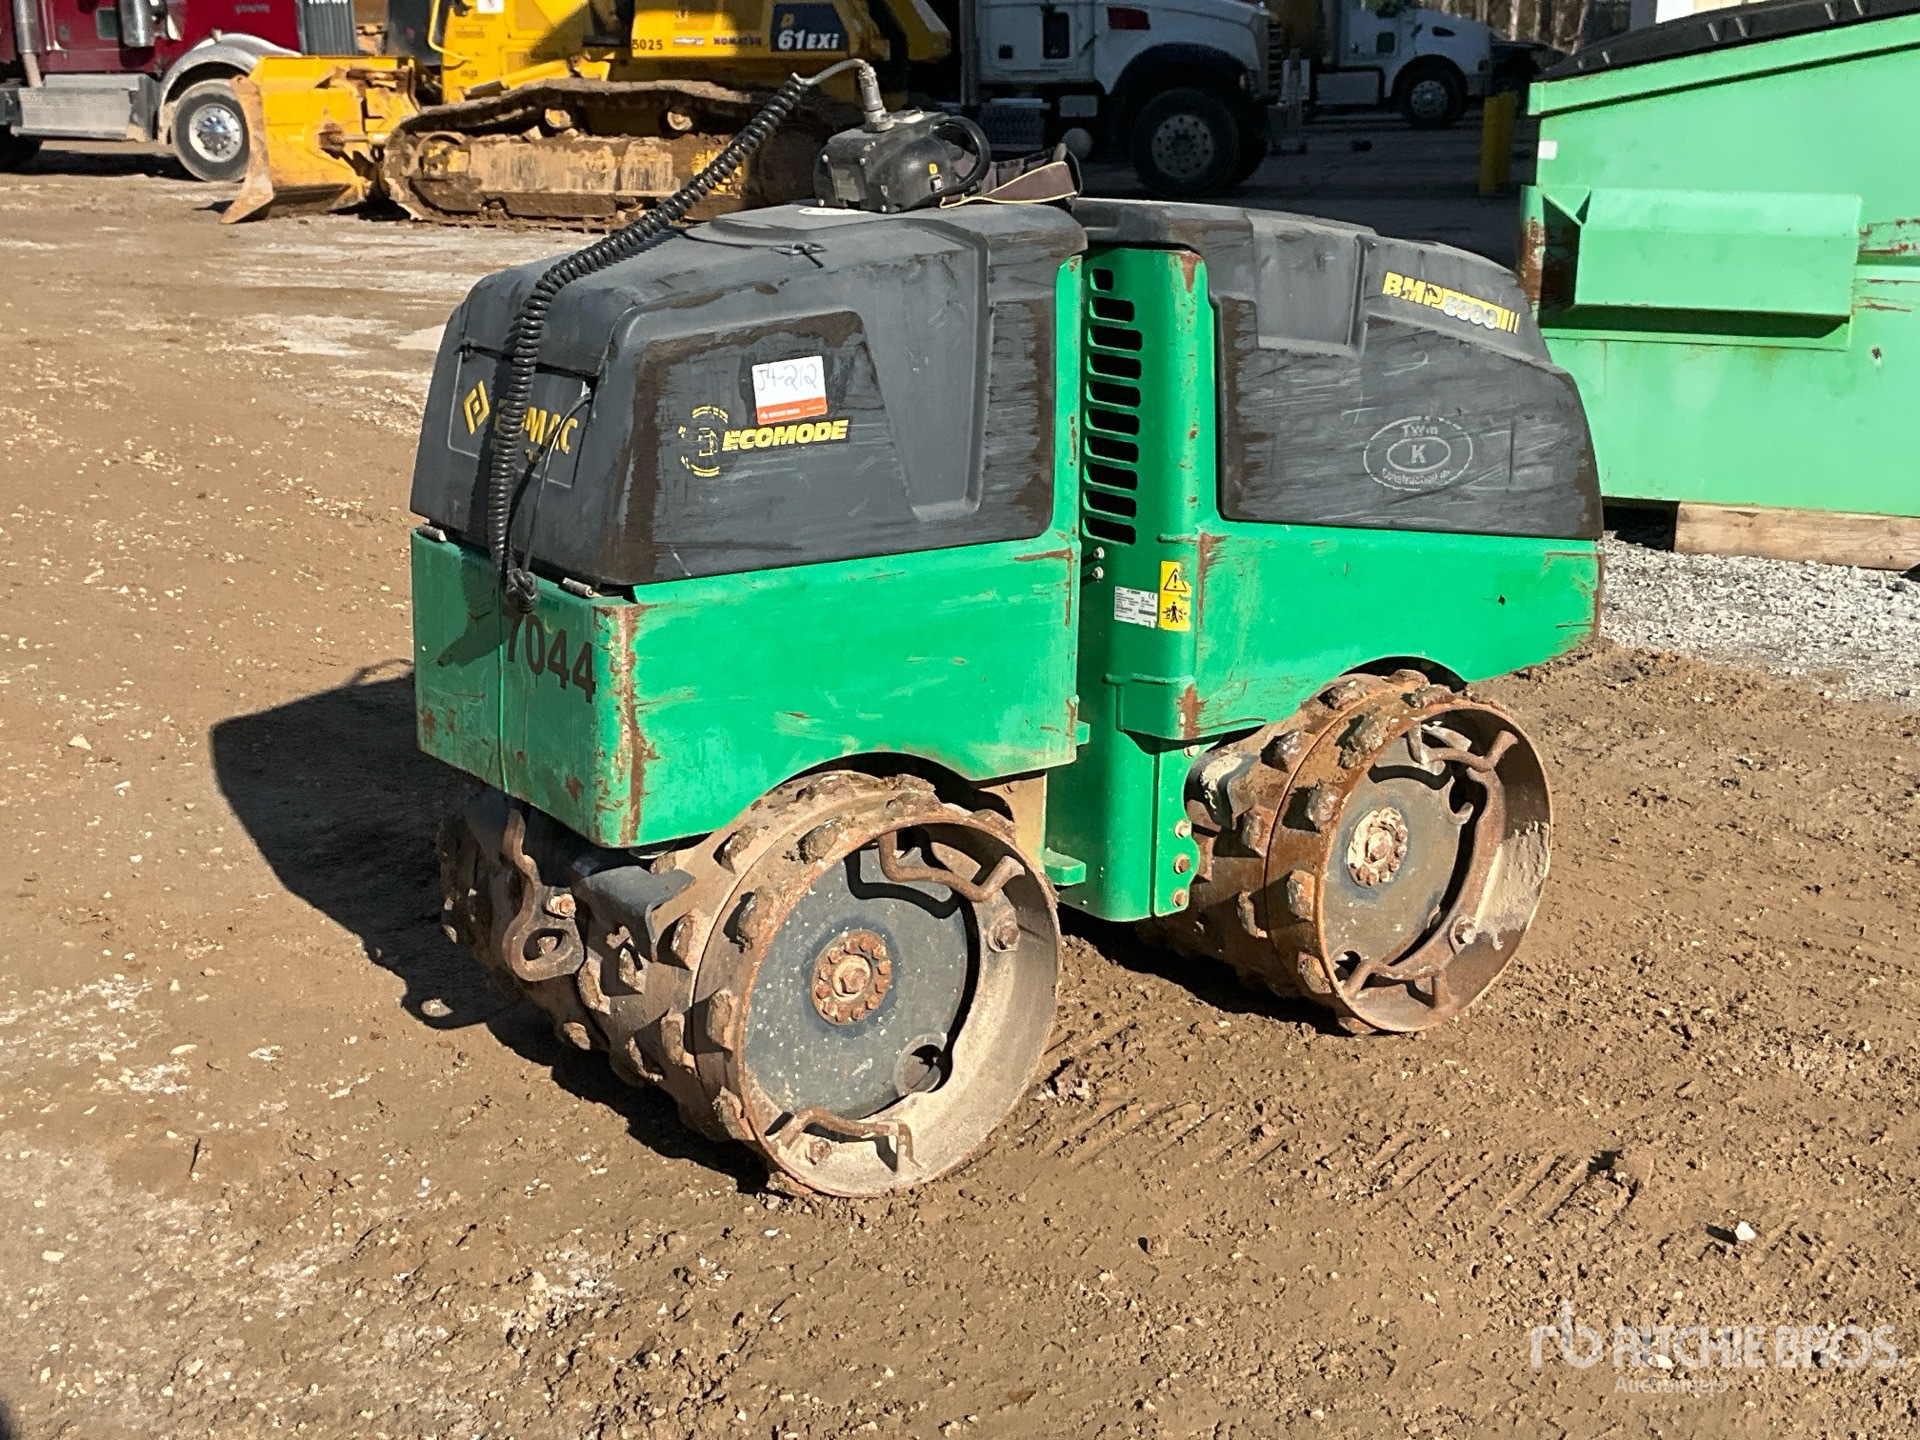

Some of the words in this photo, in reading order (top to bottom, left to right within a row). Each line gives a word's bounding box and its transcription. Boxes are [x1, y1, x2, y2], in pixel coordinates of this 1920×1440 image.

[777, 29, 840, 50] 61EXi
[1382, 271, 1444, 306] BMP
[1443, 295, 1498, 330] 8500
[721, 419, 849, 452] ECOMODE
[1410, 444, 1426, 464] K
